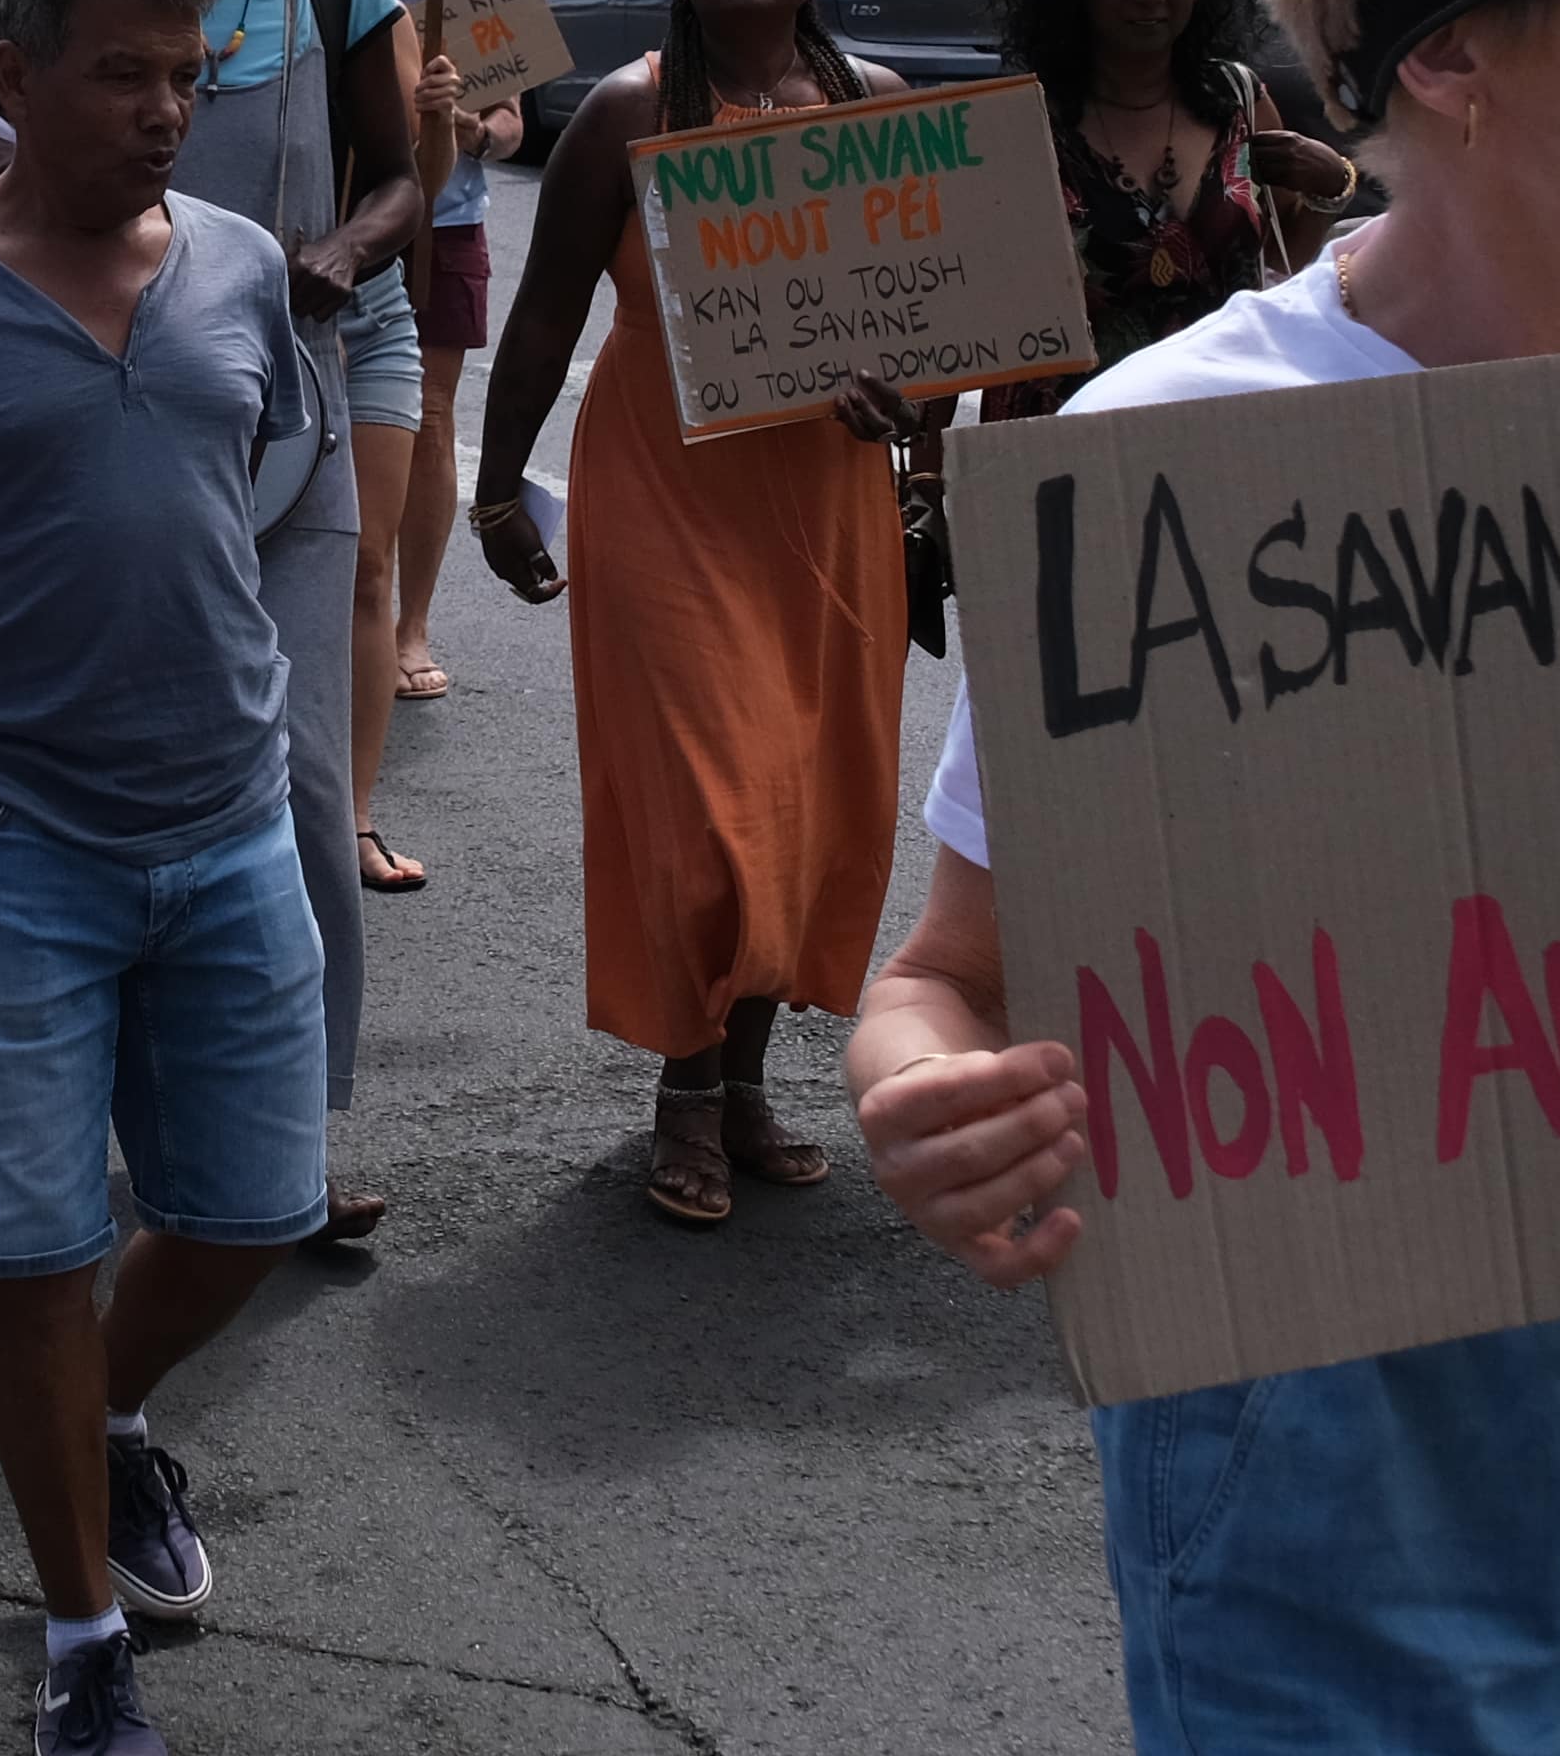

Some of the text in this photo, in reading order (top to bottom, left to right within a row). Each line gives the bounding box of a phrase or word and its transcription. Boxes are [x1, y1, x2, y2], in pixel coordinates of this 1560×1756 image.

[656, 101, 984, 211] NOUT SAVANE
[698, 198, 830, 270] NOUT
[689, 252, 967, 326] KAN OU TOUSH
[732, 300, 930, 356] LA SAVANE
[700, 379, 740, 413] OU
[756, 360, 856, 400] TOUSH
[880, 337, 998, 383] DOMOUN
[1035, 470, 1242, 740] LA
